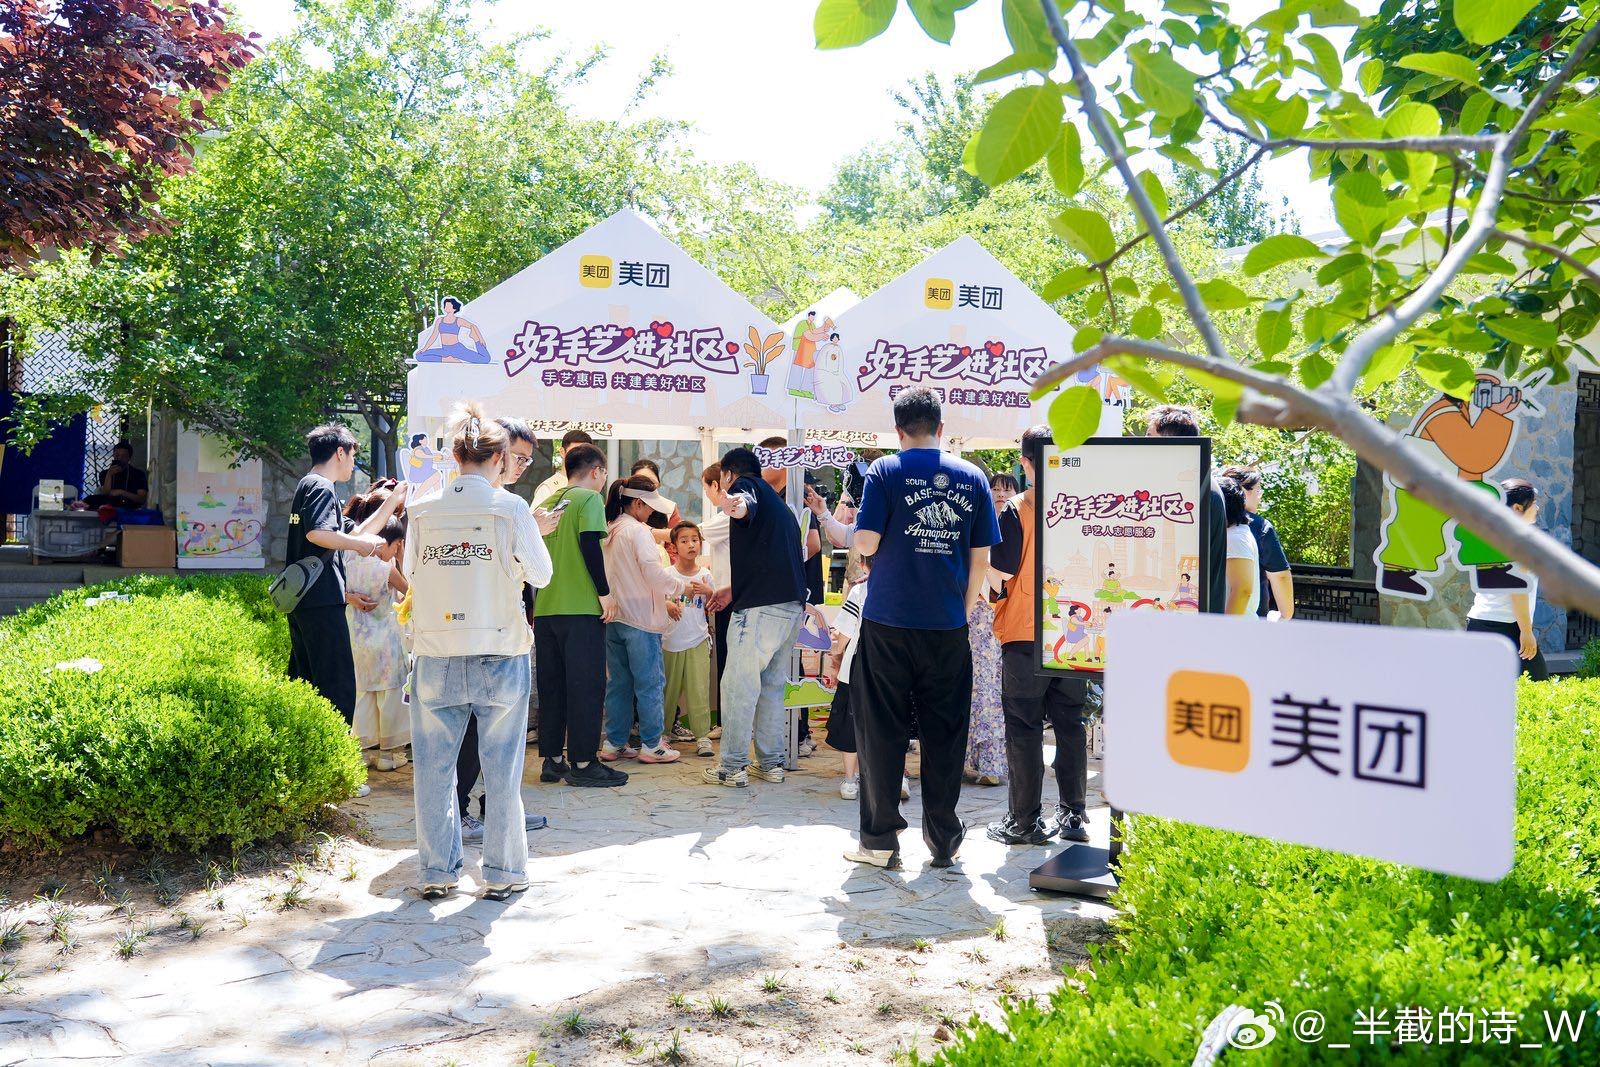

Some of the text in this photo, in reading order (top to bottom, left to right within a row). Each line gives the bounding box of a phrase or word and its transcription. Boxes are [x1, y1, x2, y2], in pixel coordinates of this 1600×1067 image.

[582, 261, 670, 288] 美团 美团
[927, 284, 1003, 310] 美团 美团
[504, 321, 739, 377] 好手艺进社区
[857, 339, 1060, 393] 好手艺进社区
[542, 369, 705, 393] 手艺惠民 共建美好社区
[950, 387, 1031, 408] 共建美好社区
[1062, 457, 1081, 468] 美团
[904, 487, 933, 506] BASE
[905, 478, 973, 491] SOUTH FACE
[1046, 490, 1194, 528] 好手艺进社区
[1082, 525, 1155, 538] 手艺人志愿服务
[1173, 693, 1428, 790] 美团 美团
